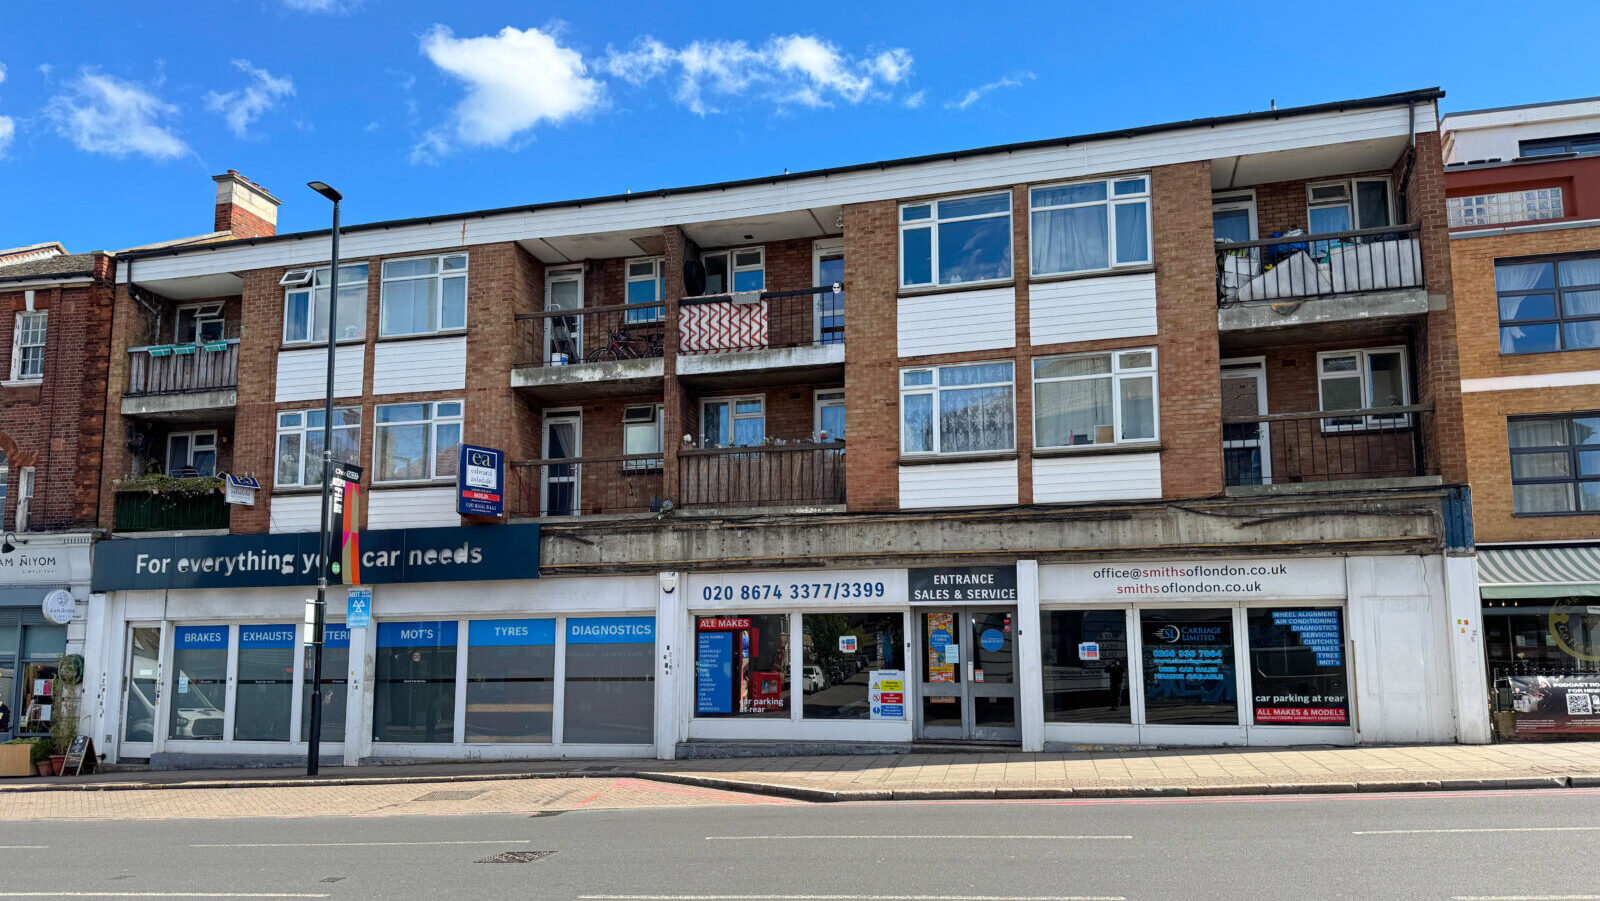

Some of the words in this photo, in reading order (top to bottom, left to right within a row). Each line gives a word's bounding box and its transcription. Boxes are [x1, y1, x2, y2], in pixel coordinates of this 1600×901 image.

[472, 452, 491, 466] ea
[136, 553, 170, 574] For
[177, 549, 295, 577] everything
[362, 550, 400, 568] car
[409, 541, 482, 566] needs
[1093, 563, 1287, 579] office@smithsoflondon.co.uk
[934, 574, 994, 585] ENTRANCE
[703, 585, 734, 600] 020
[741, 584, 782, 600] 8674
[790, 581, 885, 600] 3377/3399
[914, 589, 950, 600] SALES
[954, 589, 963, 600] &
[967, 588, 1016, 600] SERVICE
[700, 620, 716, 628] ALL
[718, 619, 749, 627] MAKES
[401, 629, 434, 640] MOT'S
[494, 626, 529, 637] TYRES
[571, 624, 652, 636] DIAGNOSTICS
[184, 632, 222, 643] BRAKES
[243, 631, 294, 642] EXHAUSTS
[754, 697, 784, 707] parking
[1273, 693, 1309, 704] parking
